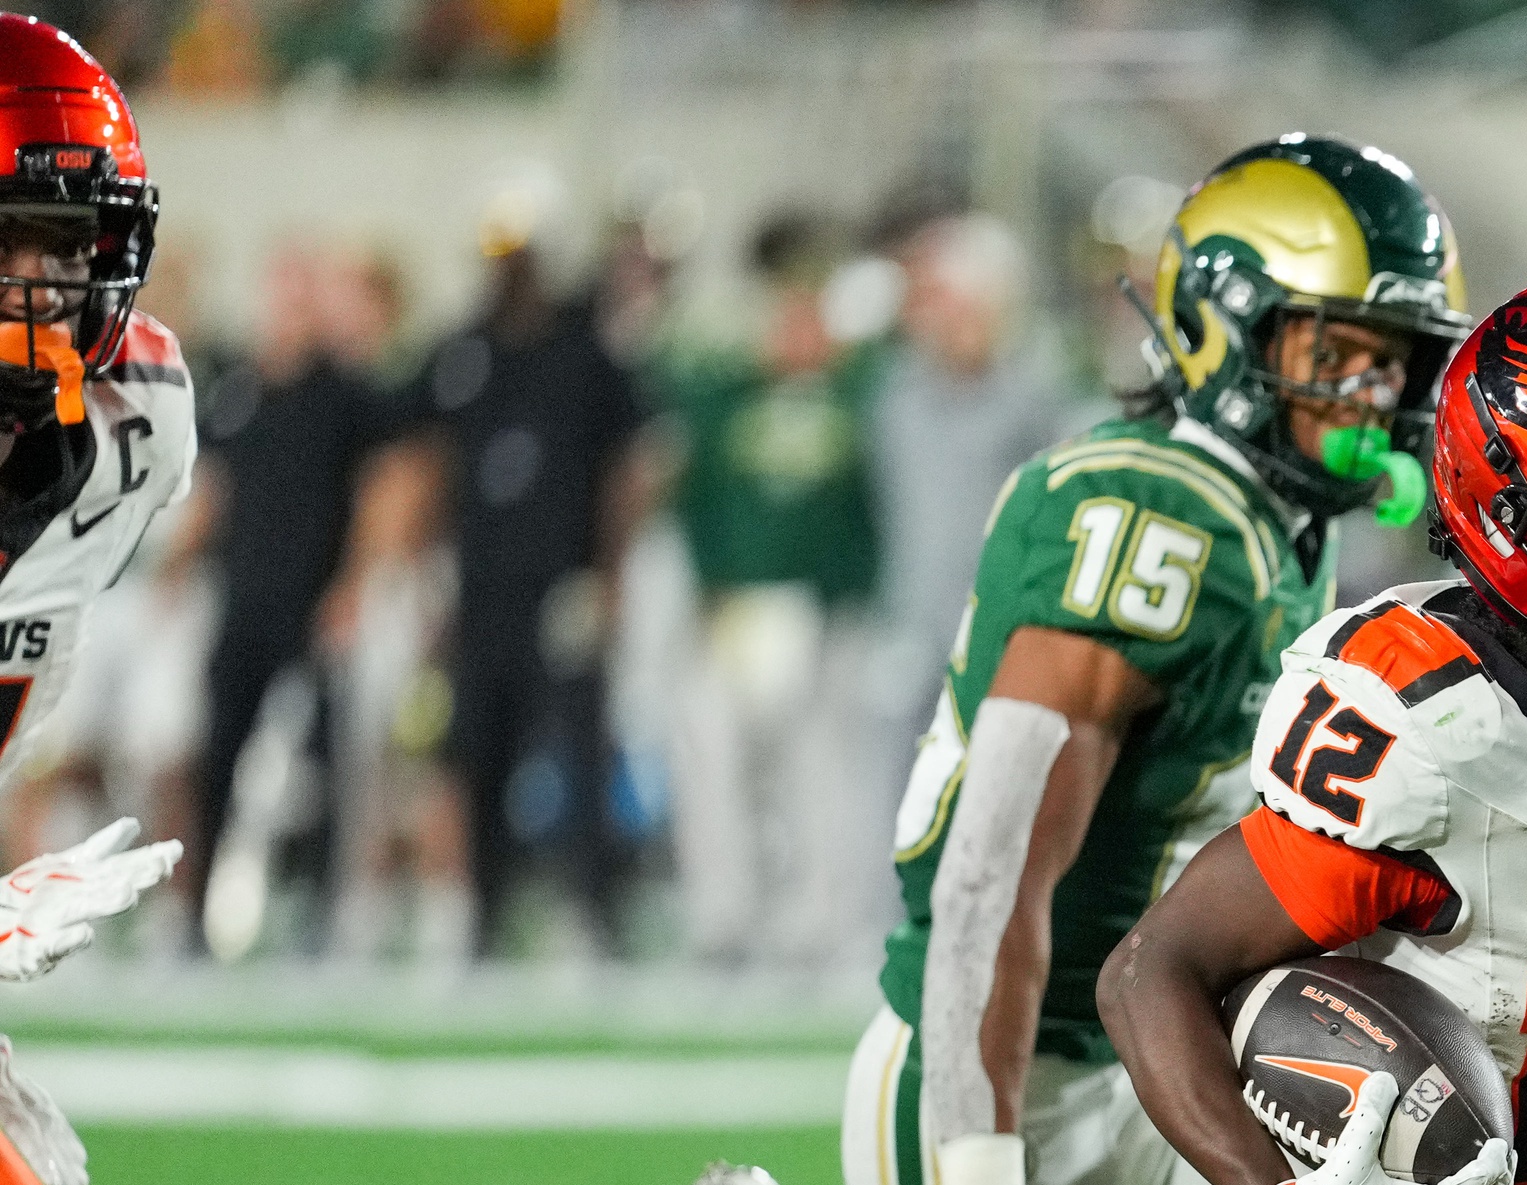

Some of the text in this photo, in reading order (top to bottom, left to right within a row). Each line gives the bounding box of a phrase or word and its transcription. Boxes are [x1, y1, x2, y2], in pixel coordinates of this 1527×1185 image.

[56, 151, 92, 170] OSU
[117, 416, 154, 493] C
[1062, 496, 1214, 642] 15
[1268, 677, 1398, 828] 12
[1300, 985, 1398, 1053] VAPOR ELITE
